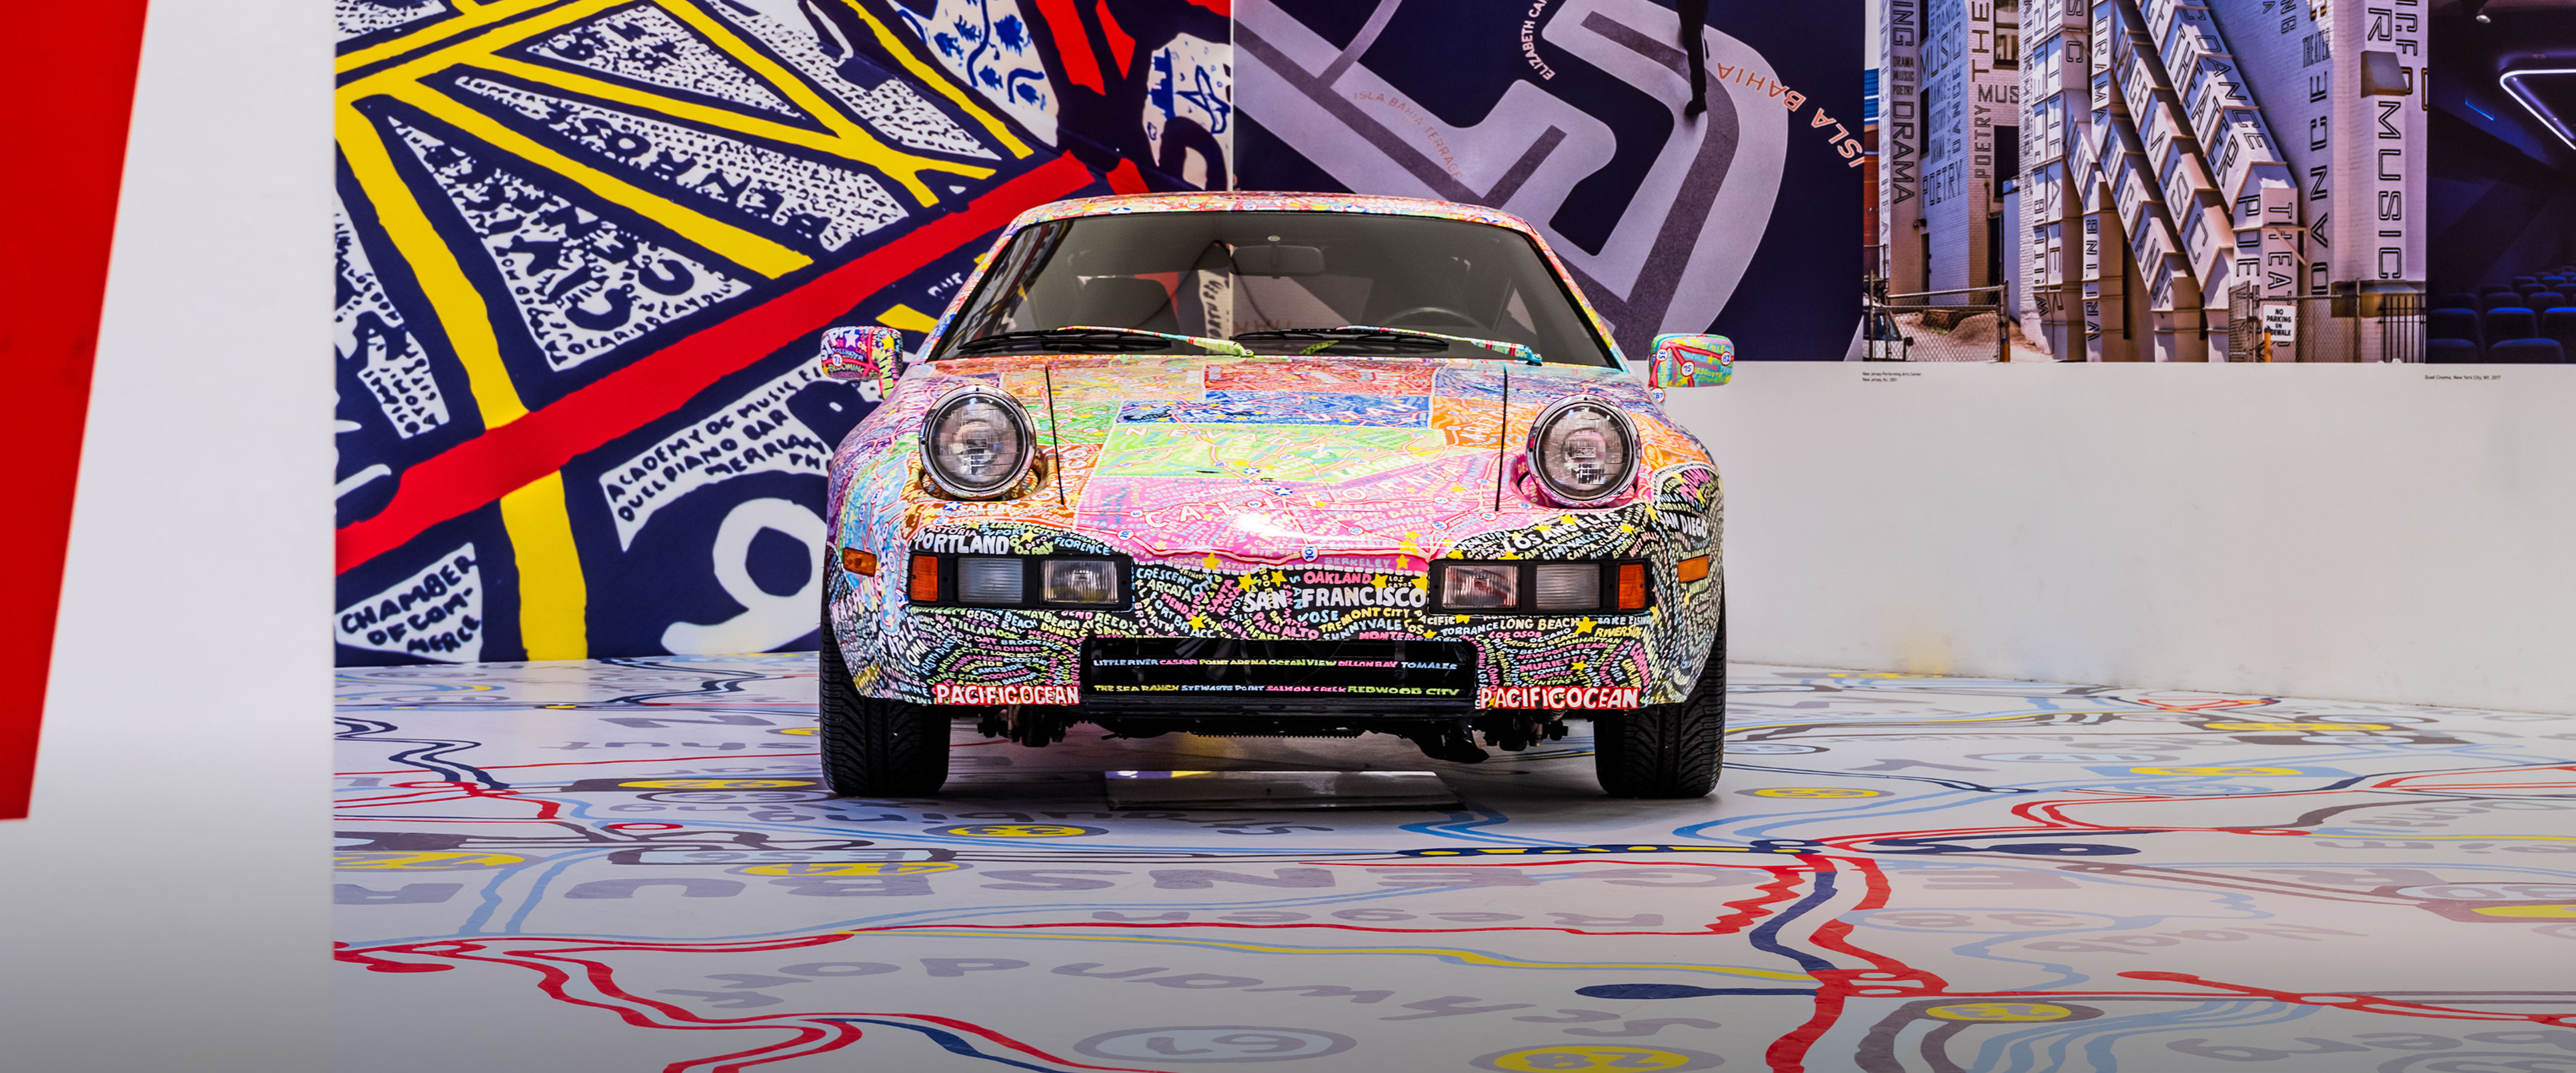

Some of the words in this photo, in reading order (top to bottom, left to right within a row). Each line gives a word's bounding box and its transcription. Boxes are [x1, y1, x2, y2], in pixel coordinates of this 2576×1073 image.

[1521, 21, 1555, 80] ELIZABETH
[1971, 1, 1989, 82] THE
[2302, 28, 2330, 68] THEATER
[1893, 56, 1914, 68] DRAMA
[1920, 21, 1961, 86] MUSIC
[1893, 69, 1914, 82] MUSIC
[1717, 63, 1806, 112] BAHIA
[1893, 84, 1914, 95] POETRY
[2195, 35, 2272, 150] DANCE
[1952, 65, 1962, 154] DANCE
[2168, 23, 2239, 188] THEATER
[1354, 91, 1384, 101] ISLA
[1389, 97, 1423, 126] BAHIA
[1425, 126, 1463, 181] TERRACE
[1811, 108, 1865, 167] ISLA
[1974, 105, 1991, 178] POETRY
[1893, 101, 1915, 204] DRAMA
[1923, 158, 1962, 208] POETRY
[2310, 72, 2328, 295] DANCE
[2378, 101, 2402, 279] MUSIC
[1305, 403, 1419, 422] UTAH
[1125, 426, 1328, 457] NEVADA
[607, 429, 704, 503] ACADEMY
[706, 415, 734, 435] OF
[662, 438, 738, 482] PIANO
[1145, 465, 1468, 528] CALIFORNIA
[1330, 502, 1403, 510] FRESNO
[959, 504, 1012, 513] SALEM
[1388, 506, 1436, 518] DAVIS
[927, 525, 977, 537] ASTORIA
[1501, 533, 1542, 553] LOS
[1542, 513, 1622, 541] ANGELES
[1657, 510, 1679, 529] SAN
[1680, 515, 1707, 538] DIEGO
[915, 527, 1009, 554] PORTLAND
[1054, 536, 1111, 555] FLORENCE
[1542, 545, 1570, 560] SIMI
[1567, 531, 1607, 547] VALLEY
[1589, 532, 1630, 560] HOLLYWOOD
[1628, 538, 1644, 557] WEST
[1325, 557, 1390, 568] BERKELEY
[1136, 567, 1193, 587] CRESCENT
[1303, 571, 1372, 584] OAKLAND
[341, 556, 475, 634] CHAMBER
[1147, 579, 1191, 602] ARCATA
[1206, 579, 1235, 613] SANTA
[1242, 589, 1288, 612] SAN
[1301, 587, 1426, 608] FRANCISCO
[1150, 591, 1175, 619] FORT
[1217, 587, 1243, 616] ROSA
[1004, 611, 1038, 628] BEACH
[1044, 612, 1080, 629] BEACH
[1297, 609, 1339, 623] JOSE
[1383, 608, 1410, 618] CITY
[1414, 610, 1456, 626] PACIFIC
[950, 617, 1021, 640] TILLAMOOK
[1001, 620, 1026, 634] BAY
[1041, 622, 1078, 638] DUNES
[1253, 612, 1280, 633] PALO
[1281, 625, 1319, 639] ALTO
[1323, 618, 1402, 640] SUNNYVALE
[1441, 623, 1499, 636] TORRANCE
[1500, 619, 1534, 629] LONG
[1538, 617, 1580, 631] BEACH
[1594, 624, 1643, 639] RIVERSIDE
[367, 623, 406, 646] OF
[407, 615, 481, 653] MERCE
[1028, 629, 1068, 642] NESIKA
[1503, 638, 1546, 648] GROVER
[1547, 633, 1579, 645] BEACH
[1530, 628, 1572, 642] OCEANO
[1557, 638, 1623, 648] MANHATTAN
[979, 643, 1041, 652] GARDINER
[1476, 634, 1497, 664] CAMBRIA
[1516, 644, 1575, 659] NEWPORT
[1519, 645, 1555, 655] BEACH
[1546, 649, 1580, 661] JUAN
[949, 655, 1003, 672] WARRENTON
[971, 663, 1025, 675] LAKESIDE
[1401, 661, 1457, 670] TOMALES
[1496, 651, 1513, 686] GUADALUPE
[1520, 655, 1588, 672] MURIETTA
[926, 672, 957, 685] DUNE
[982, 668, 1031, 680] COQUILLE
[1520, 672, 1571, 685] ENCINITAS
[1347, 686, 1422, 694] REDWOOD
[670, 793, 806, 801] 66
[748, 811, 1335, 835] Straubing
[963, 827, 1067, 835] 33
[683, 852, 825, 862] 56
[847, 851, 906, 860] E
[772, 862, 953, 874] 44
[1092, 908, 1664, 927] Regen
[1872, 912, 2086, 928] 38
[2023, 924, 2371, 955] Naab
[656, 958, 1721, 1037] Schwandorf
[1953, 1005, 2059, 1019] 23
[1524, 1051, 1666, 1069] 28
